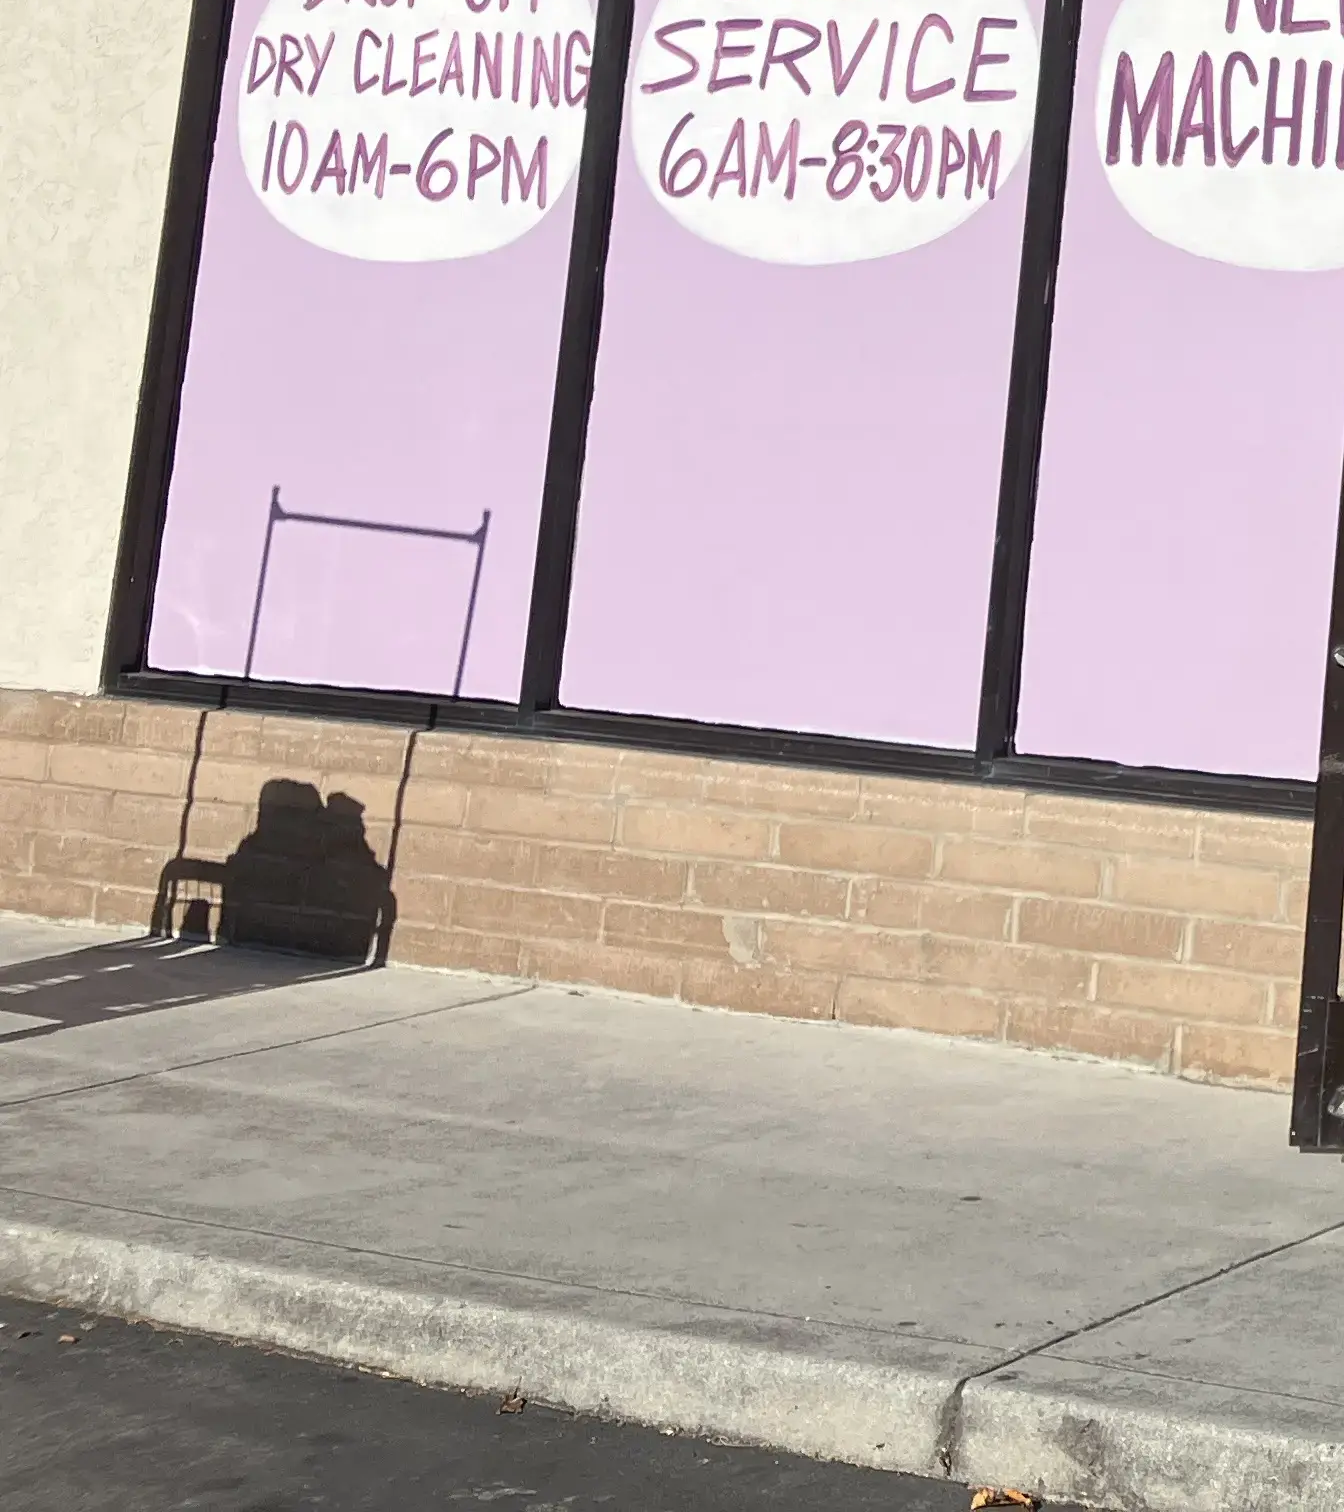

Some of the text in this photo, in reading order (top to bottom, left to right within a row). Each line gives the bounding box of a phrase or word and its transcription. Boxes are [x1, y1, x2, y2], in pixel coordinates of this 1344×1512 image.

[247, 29, 592, 109] DRY CLEANING
[641, 13, 1018, 103] SERVICE
[261, 119, 549, 209] 10AM-6PM
[659, 111, 1001, 201] 6AM-8:30PM
